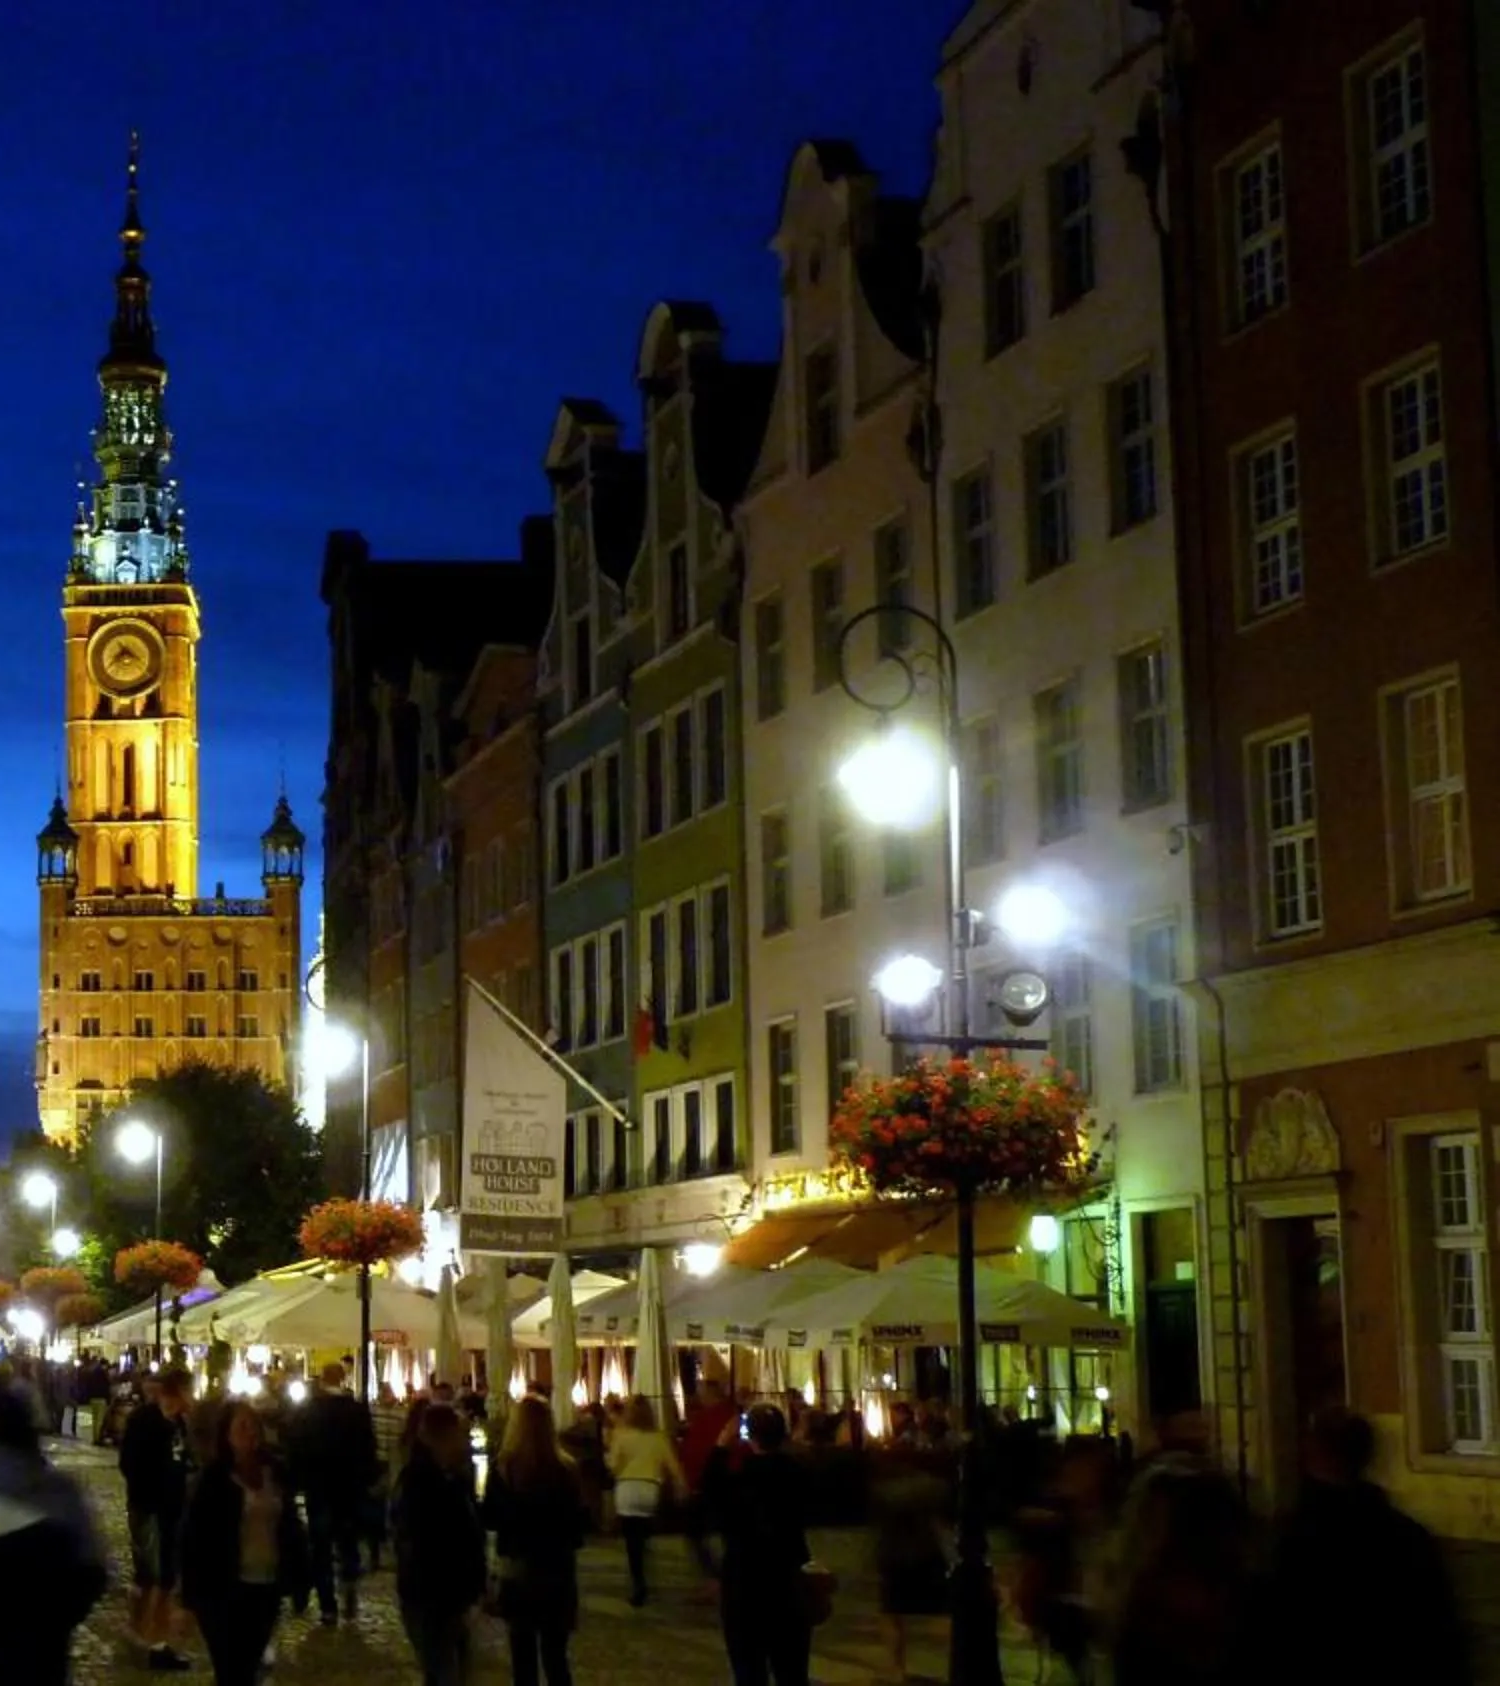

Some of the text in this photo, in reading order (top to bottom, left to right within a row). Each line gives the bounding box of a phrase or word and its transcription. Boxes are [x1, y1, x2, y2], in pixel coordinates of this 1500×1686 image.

[473, 1157, 551, 1176] HOLLAND
[486, 1176, 536, 1193] HOUSE
[468, 1196, 556, 1214] RESIDENCE
